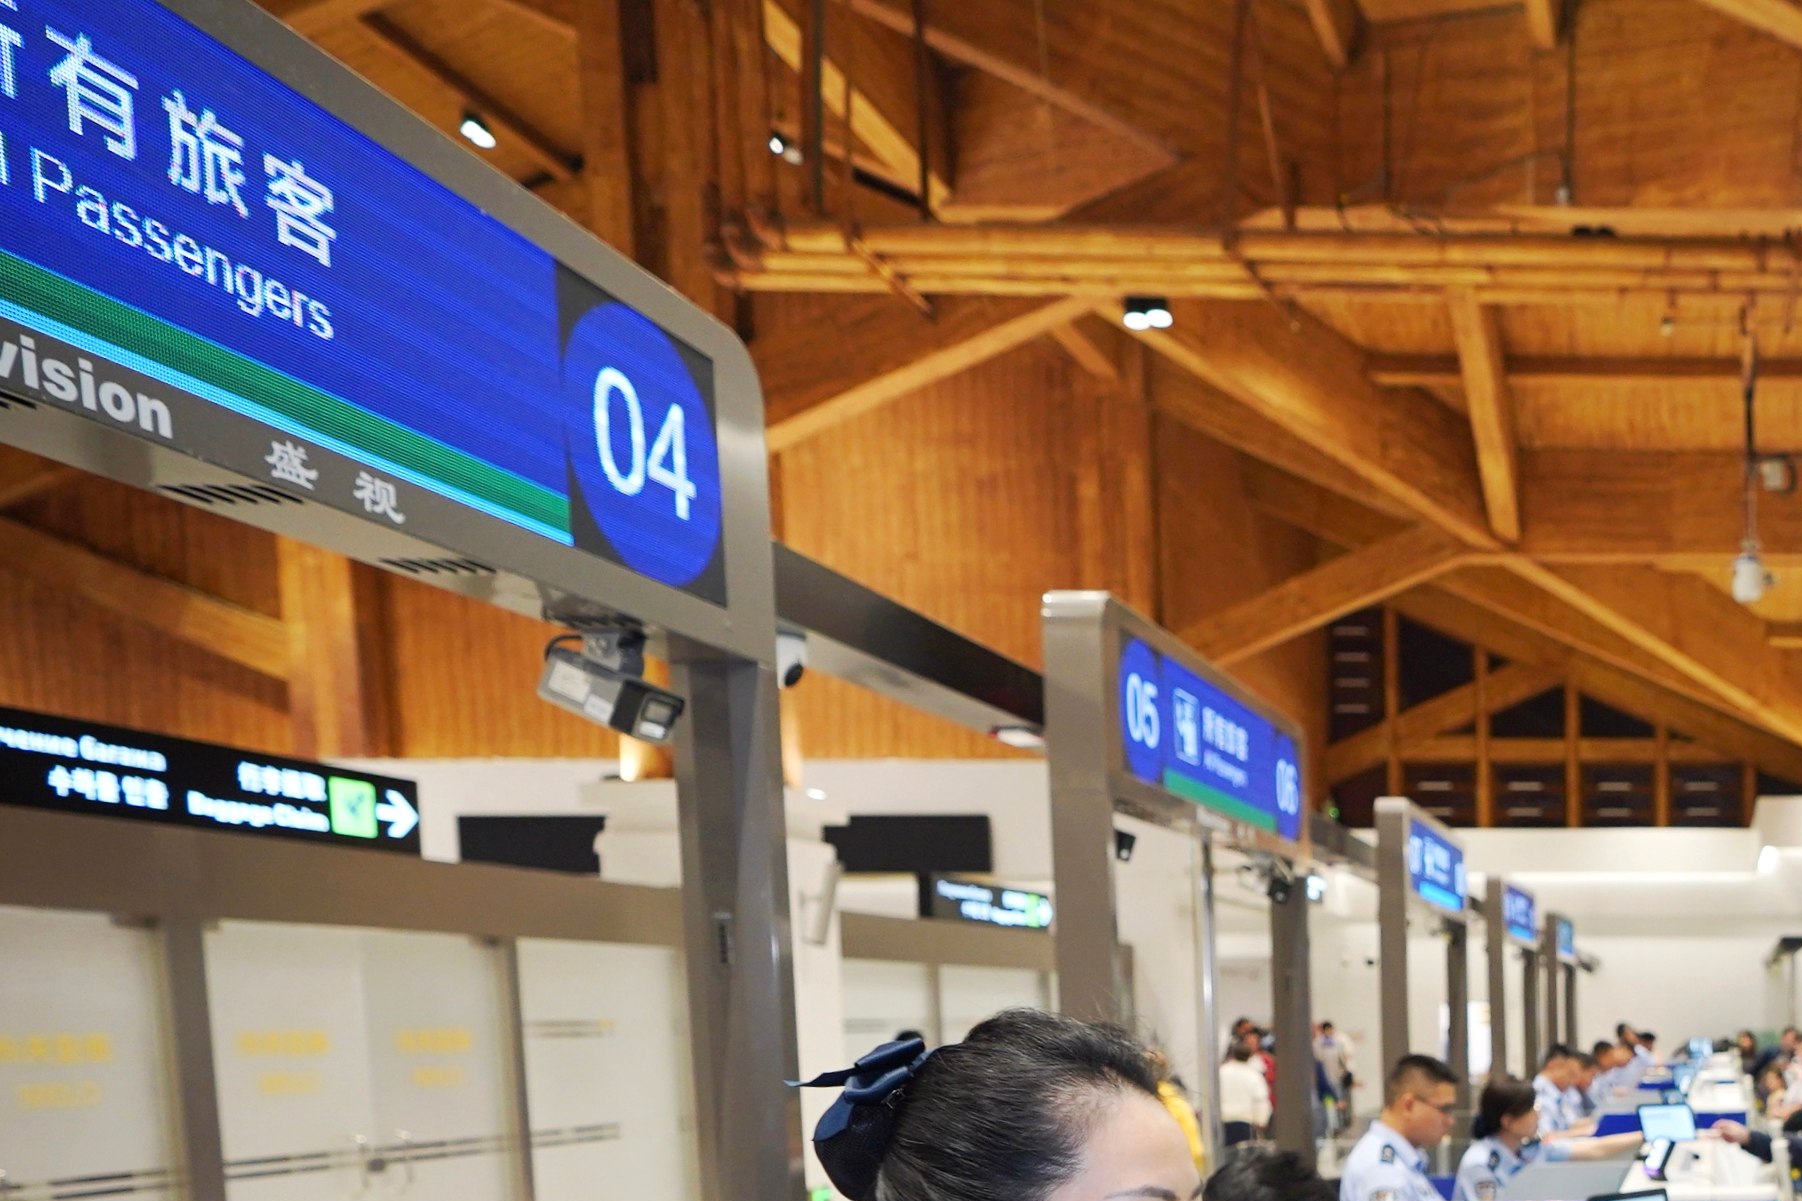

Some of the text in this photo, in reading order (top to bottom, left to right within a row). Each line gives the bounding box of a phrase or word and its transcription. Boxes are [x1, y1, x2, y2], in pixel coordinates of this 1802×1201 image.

[0, 0, 337, 268] 有旅客
[30, 146, 335, 341] Passengers
[593, 365, 697, 521] 04
[1126, 672, 1160, 750] 05
